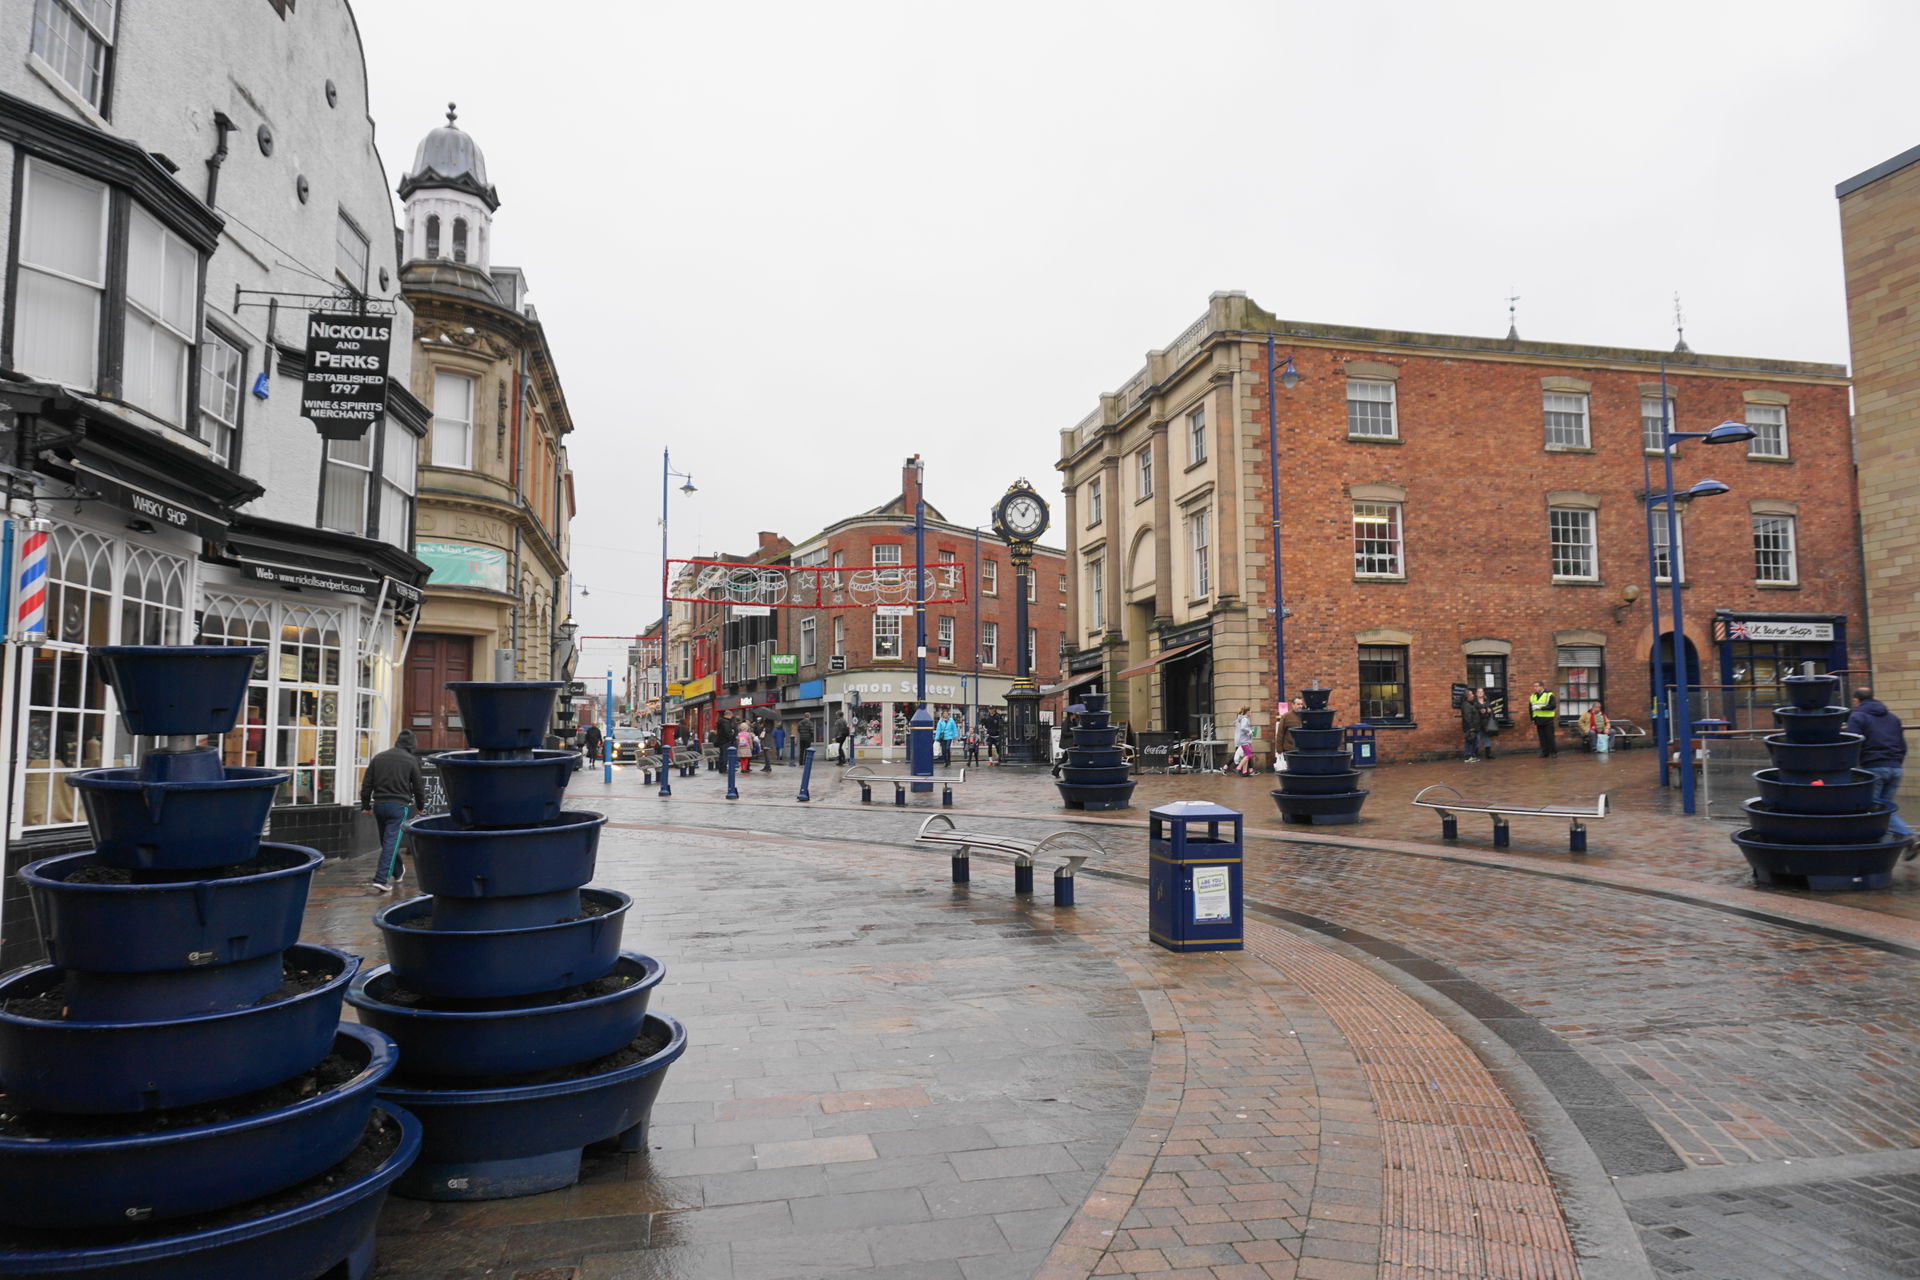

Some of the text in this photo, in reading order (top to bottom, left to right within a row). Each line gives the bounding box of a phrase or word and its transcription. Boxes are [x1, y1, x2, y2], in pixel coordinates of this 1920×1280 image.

[310, 321, 390, 341] NICKOLLS
[335, 341, 360, 350] AND
[314, 350, 380, 370] PERKS
[307, 372, 384, 385] ESTABLISHED
[330, 383, 360, 394] 1797
[310, 409, 375, 420] MERCHANTS
[132, 494, 188, 526] WHISKY SHOP
[455, 515, 503, 543] BANK
[843, 680, 956, 698] Lemon Seezy
